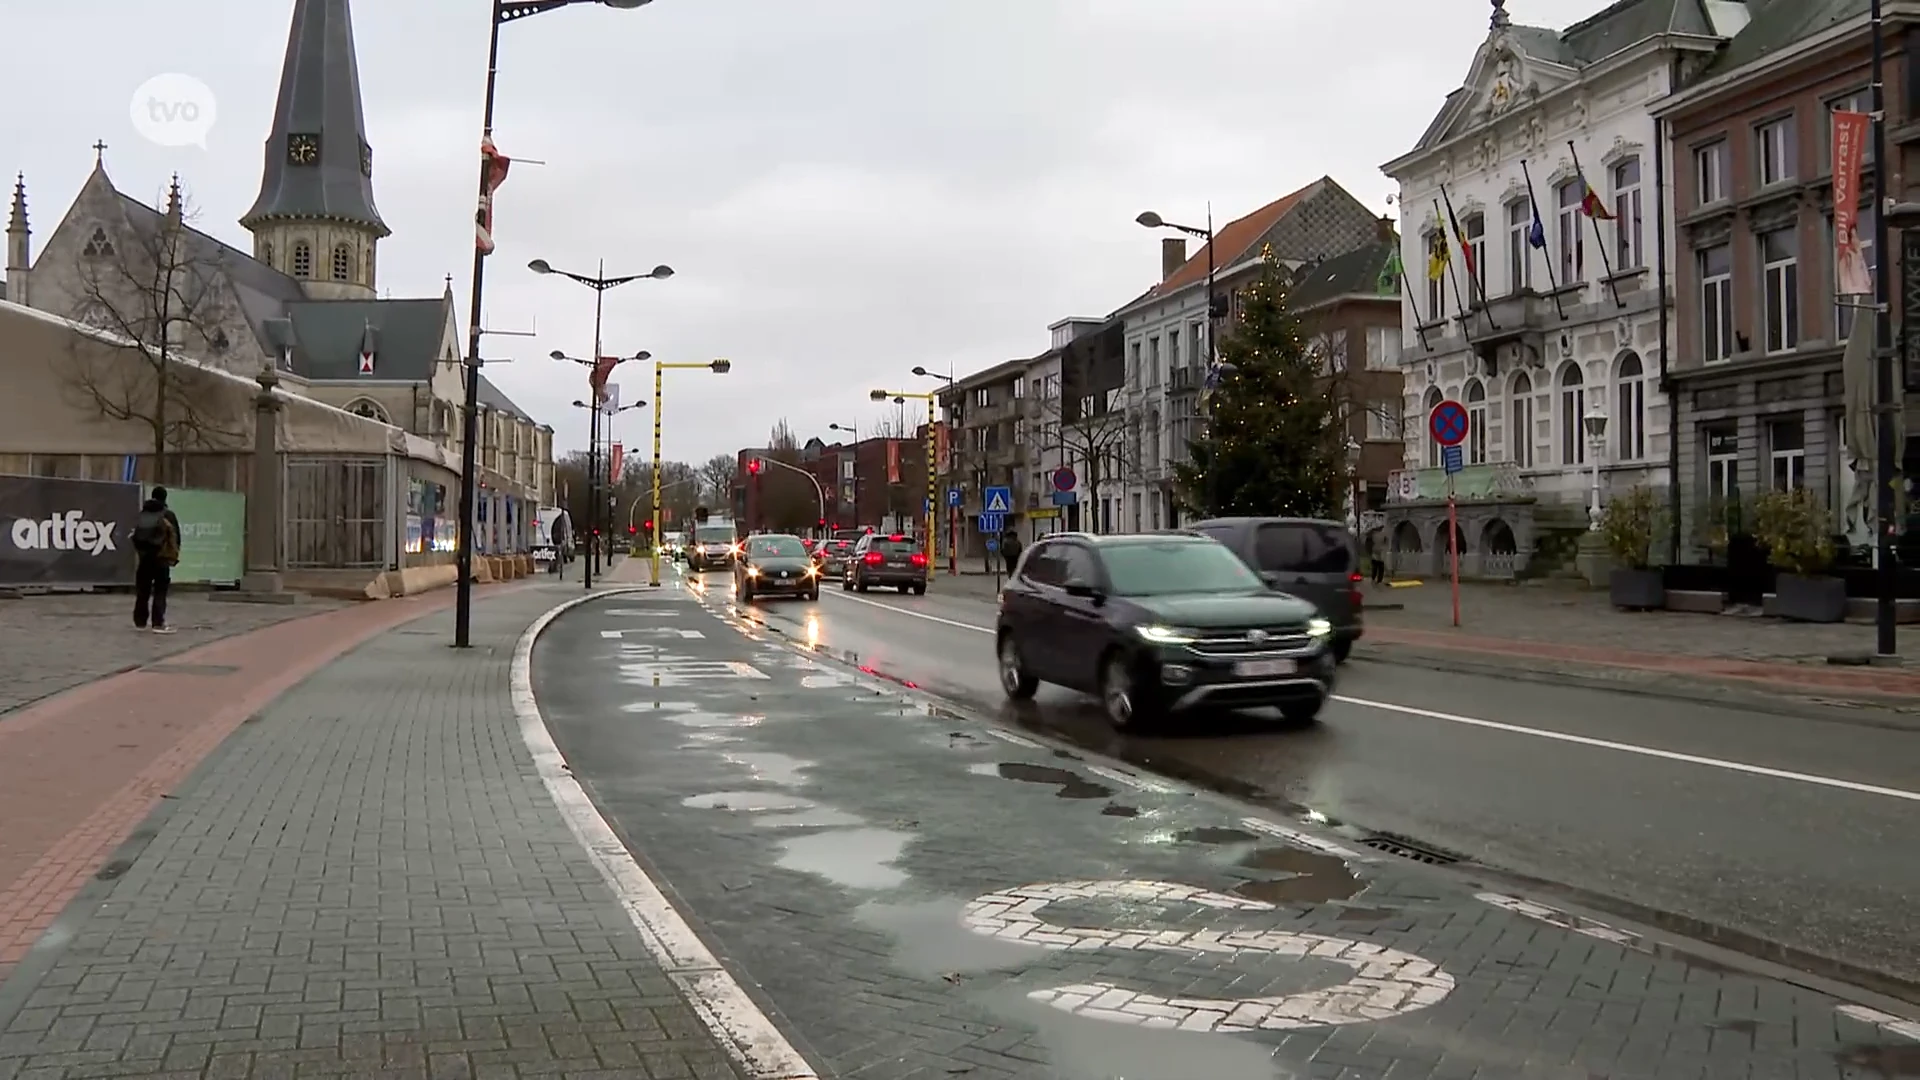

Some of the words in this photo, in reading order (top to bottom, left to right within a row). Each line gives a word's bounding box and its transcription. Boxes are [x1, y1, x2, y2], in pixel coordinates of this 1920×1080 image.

[1836, 122, 1851, 204] Verrast
[949, 491, 958, 504] P
[11, 510, 116, 556] artfex
[533, 547, 556, 561] artfex
